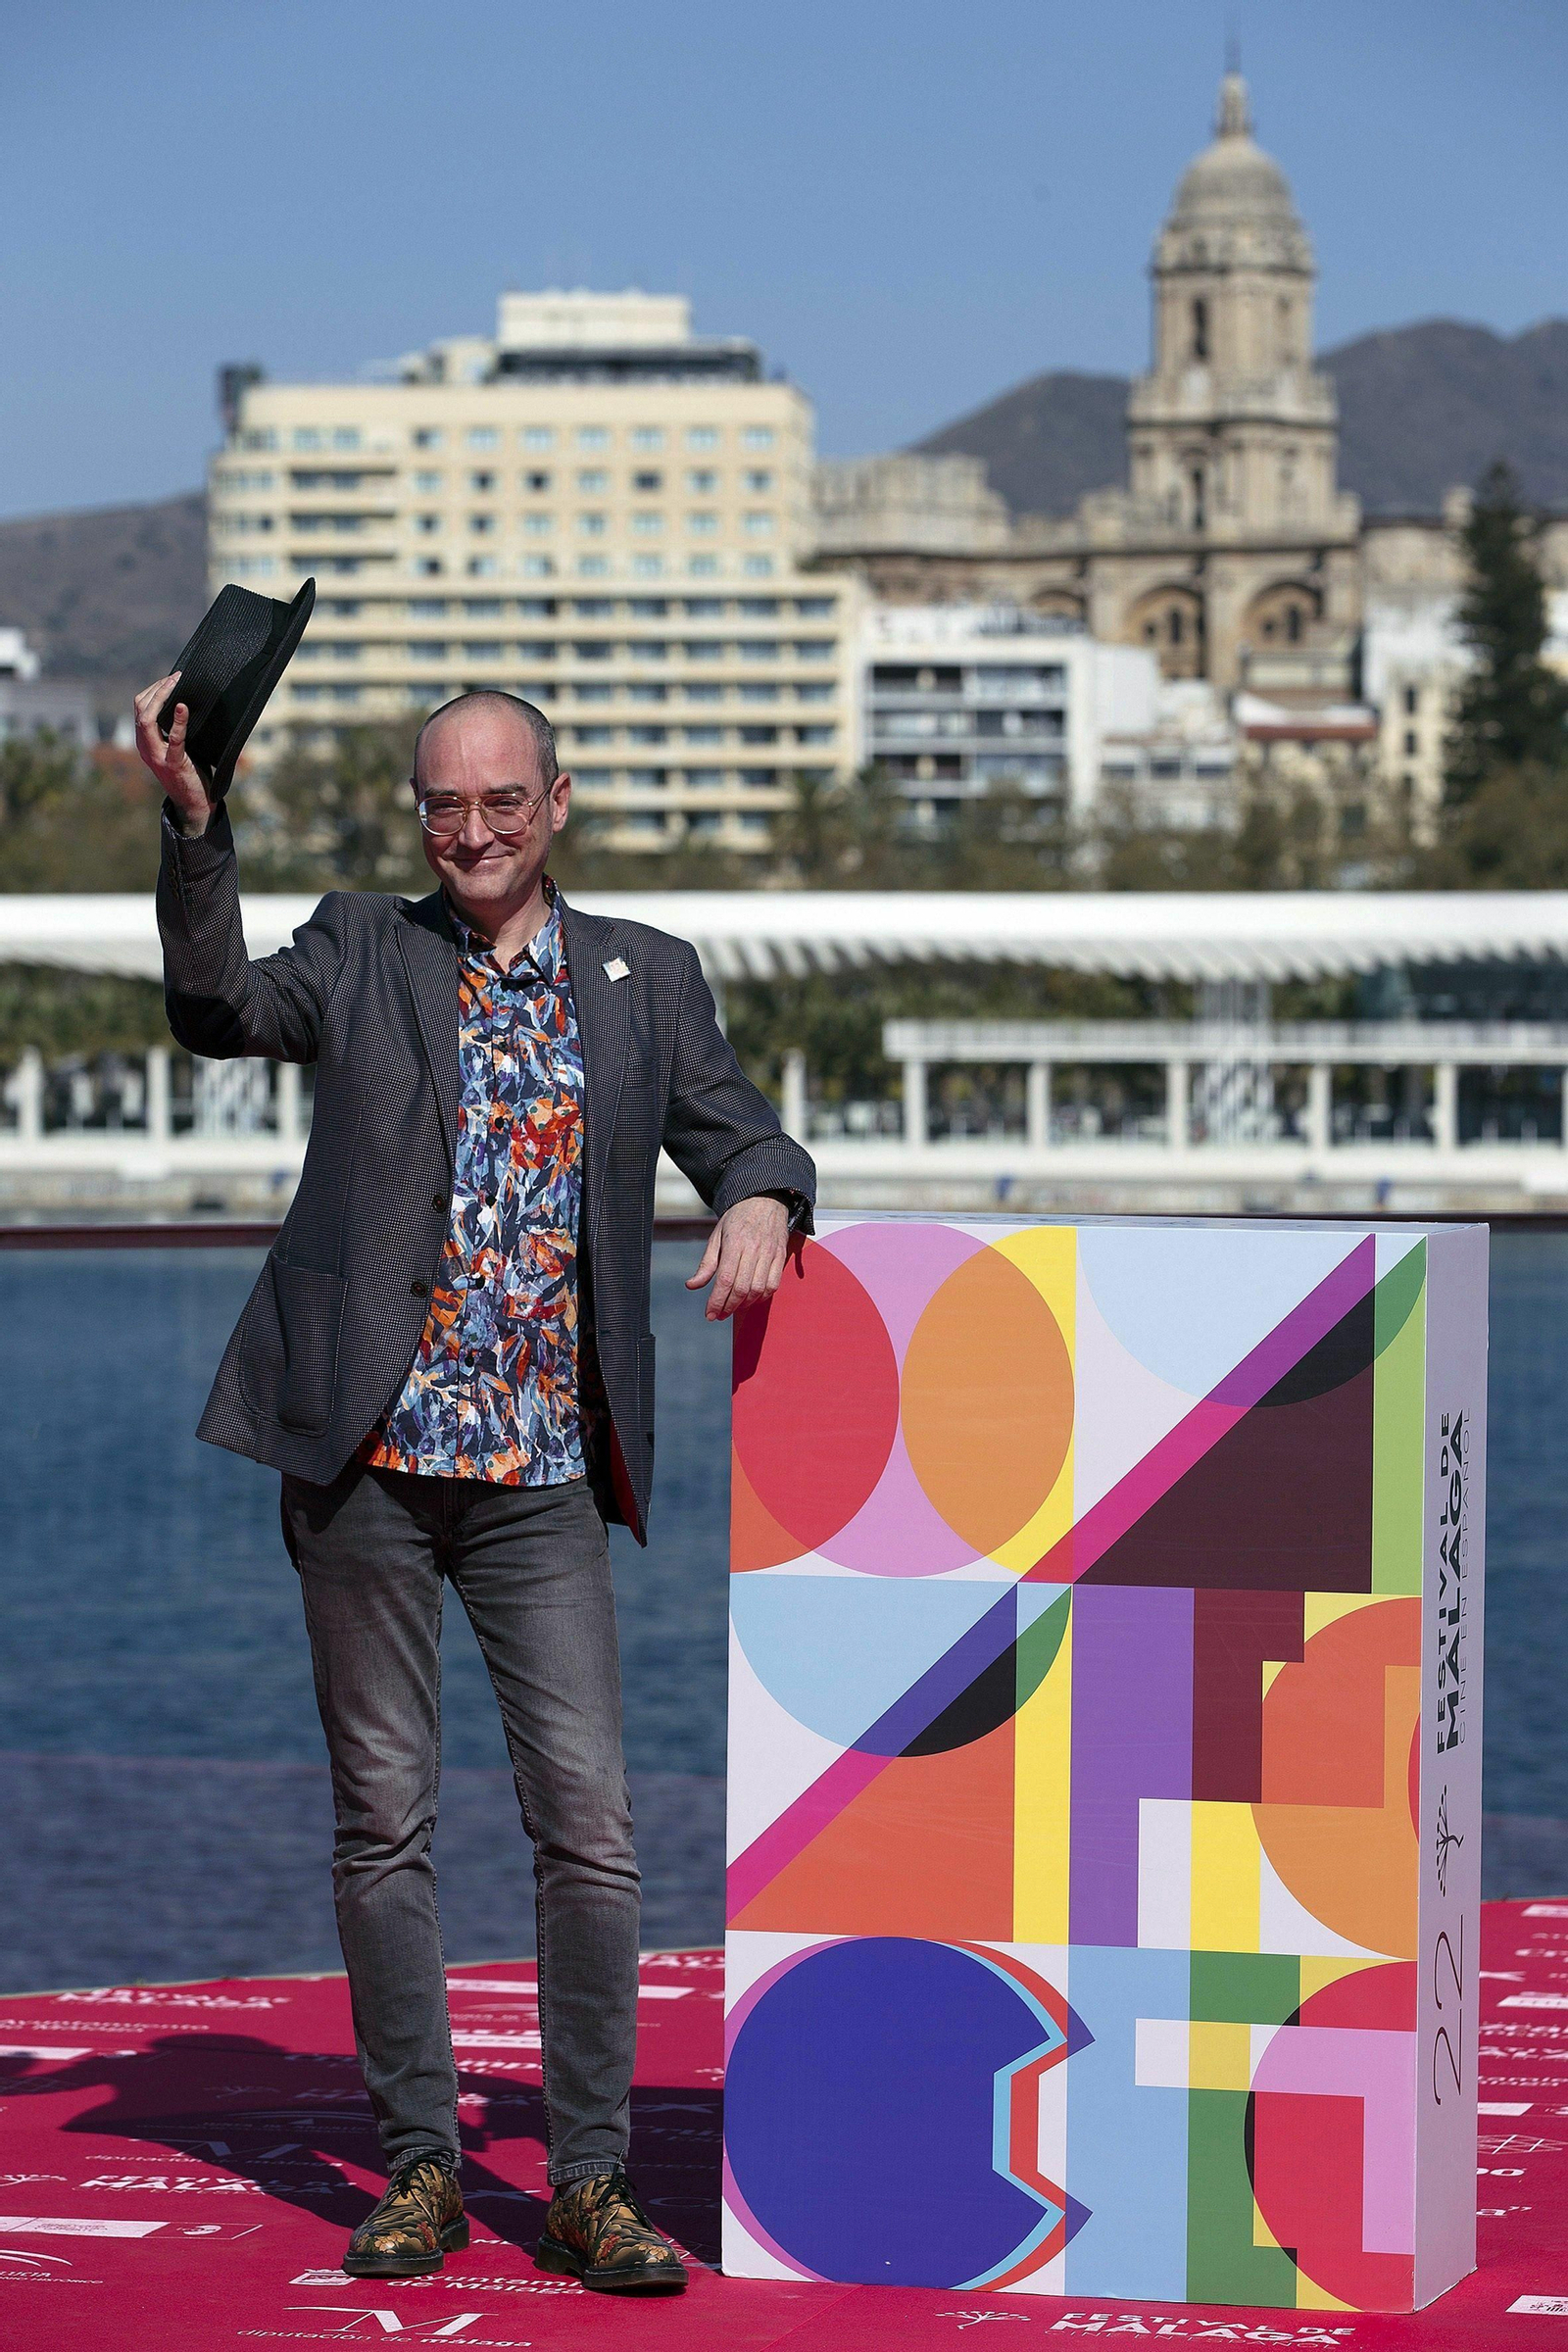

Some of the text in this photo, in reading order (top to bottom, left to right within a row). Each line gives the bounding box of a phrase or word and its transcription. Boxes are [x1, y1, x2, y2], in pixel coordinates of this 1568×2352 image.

[1437, 1412, 1449, 1754] FESTIVAL DE
[1460, 1596, 1468, 1640] EN
[1433, 1914, 1463, 2105] 22
[96, 2174, 282, 2185] FESTIVAL
[1060, 2312, 1356, 2335] FESTIVAL DE
